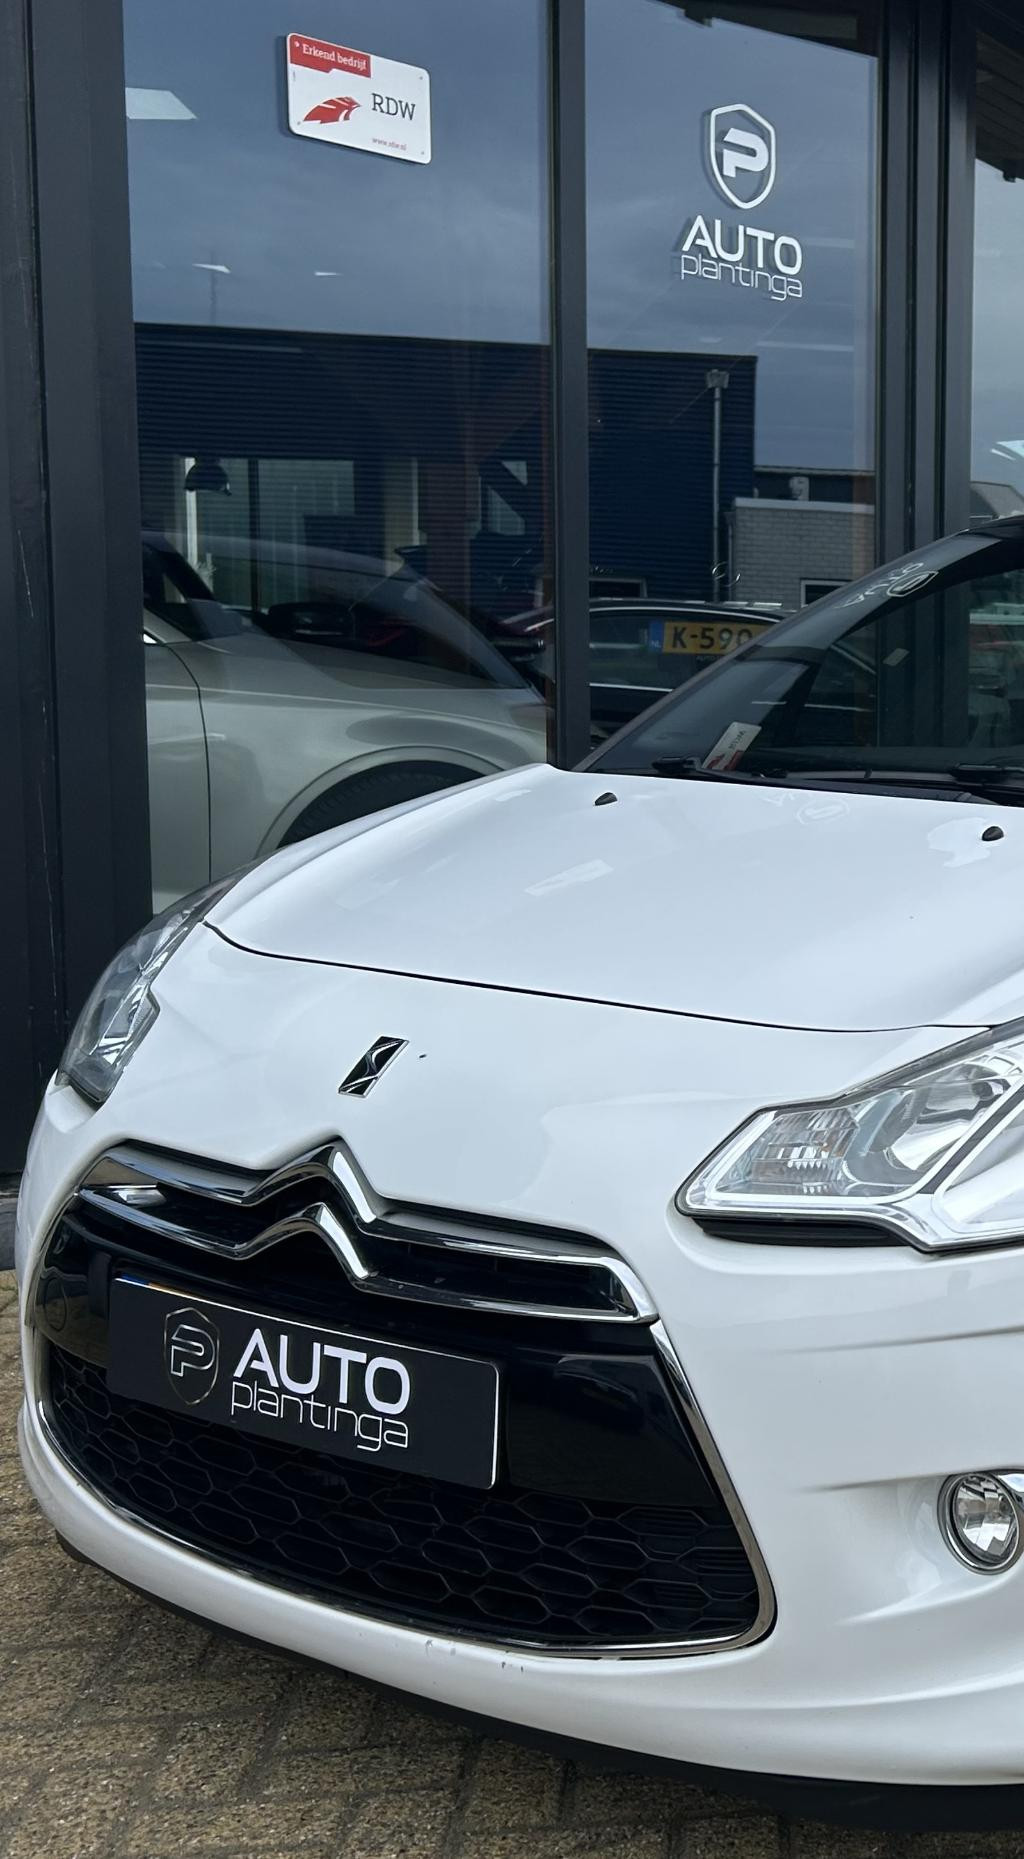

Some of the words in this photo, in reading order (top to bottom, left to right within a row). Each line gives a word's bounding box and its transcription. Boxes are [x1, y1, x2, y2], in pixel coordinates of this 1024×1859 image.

[302, 43, 336, 61] Erkend
[337, 53, 368, 71] bedrijf
[371, 92, 416, 121] RDW
[681, 214, 803, 276] AUTO
[680, 252, 804, 302] plantinga
[232, 1327, 412, 1416] AUTO
[231, 1380, 410, 1452] plantinga
